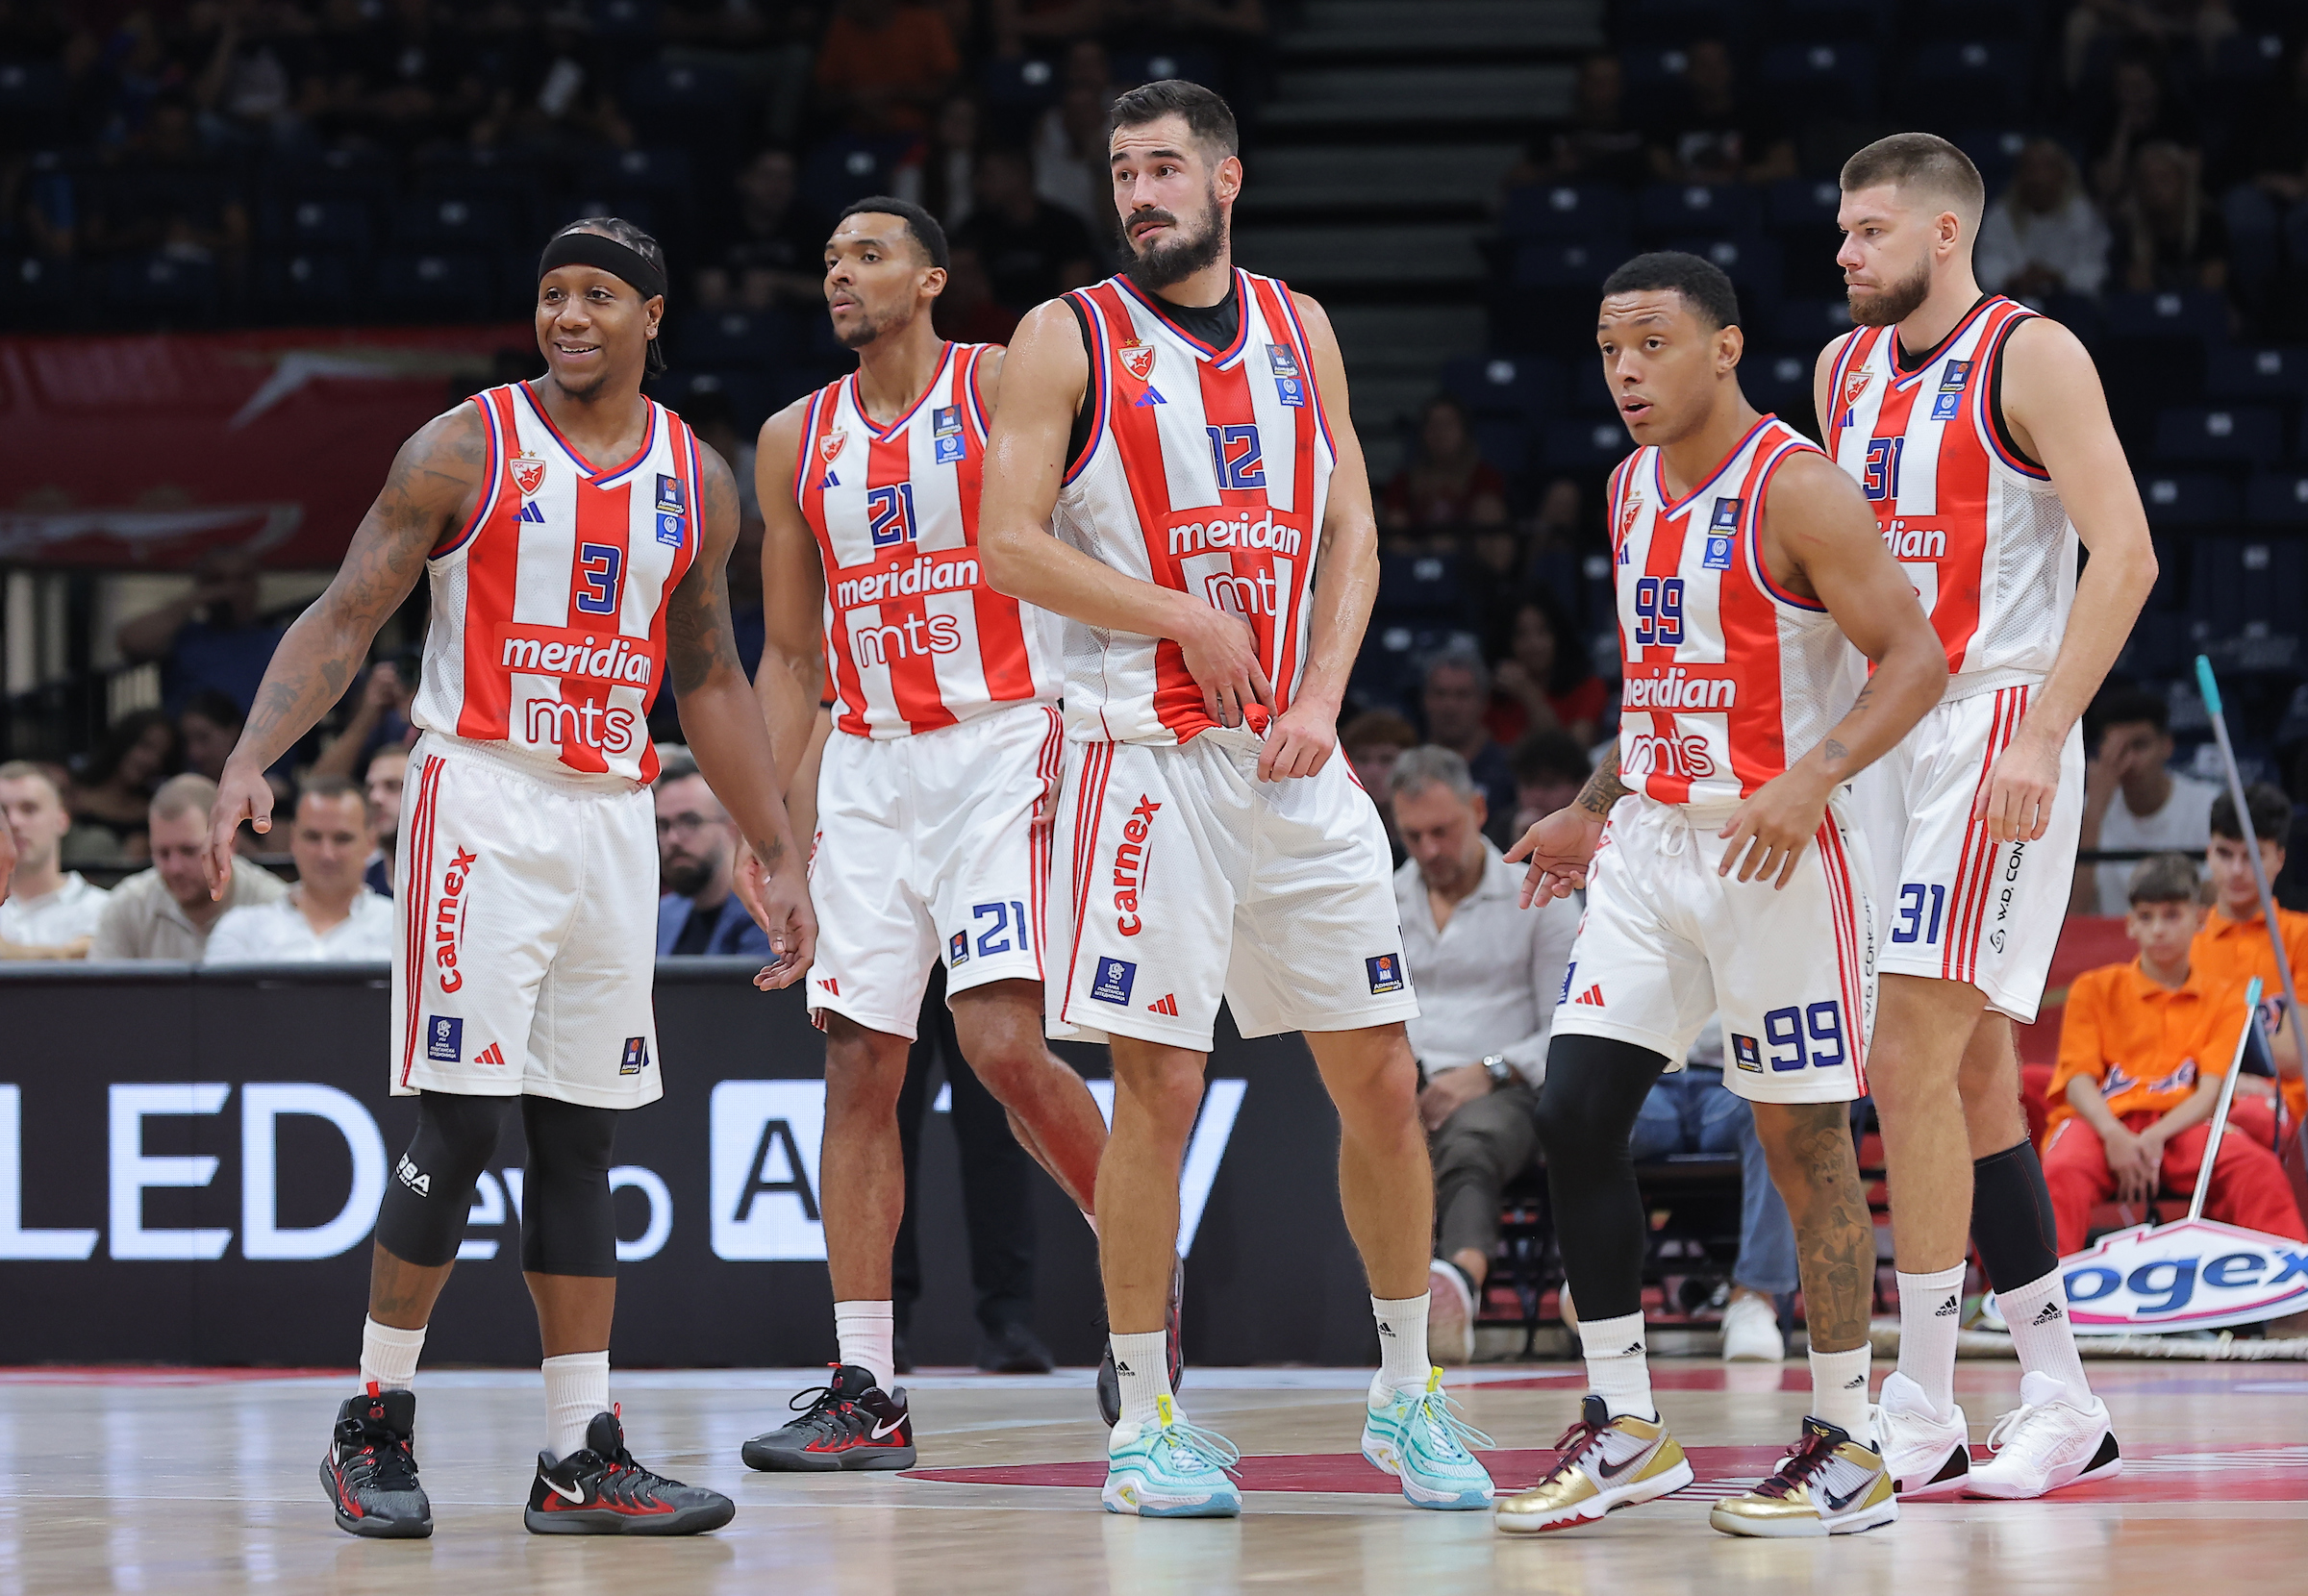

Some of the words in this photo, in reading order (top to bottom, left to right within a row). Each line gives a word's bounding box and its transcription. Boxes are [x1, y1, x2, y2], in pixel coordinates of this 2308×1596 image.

[1206, 424, 1267, 489] 12
[1863, 436, 1905, 501] 31
[867, 482, 918, 548] 21
[577, 542, 622, 614] 3
[837, 556, 979, 608] meridian
[1205, 566, 1277, 616] mt
[856, 611, 961, 667] mts
[1636, 576, 1685, 646] 99
[501, 636, 652, 686] meridian
[526, 696, 635, 753] mts
[1624, 728, 1716, 777] mts
[1114, 793, 1162, 936] carnex
[436, 845, 477, 994] carnex
[973, 901, 1028, 957] 21
[1892, 883, 1945, 944] 31
[1373, 979, 1401, 990] ADMIRAL
[1764, 1000, 1847, 1072] 99
[0, 1083, 388, 1260] LED
[455, 1165, 672, 1262] eo
[2032, 1309, 2063, 1326] adidas
